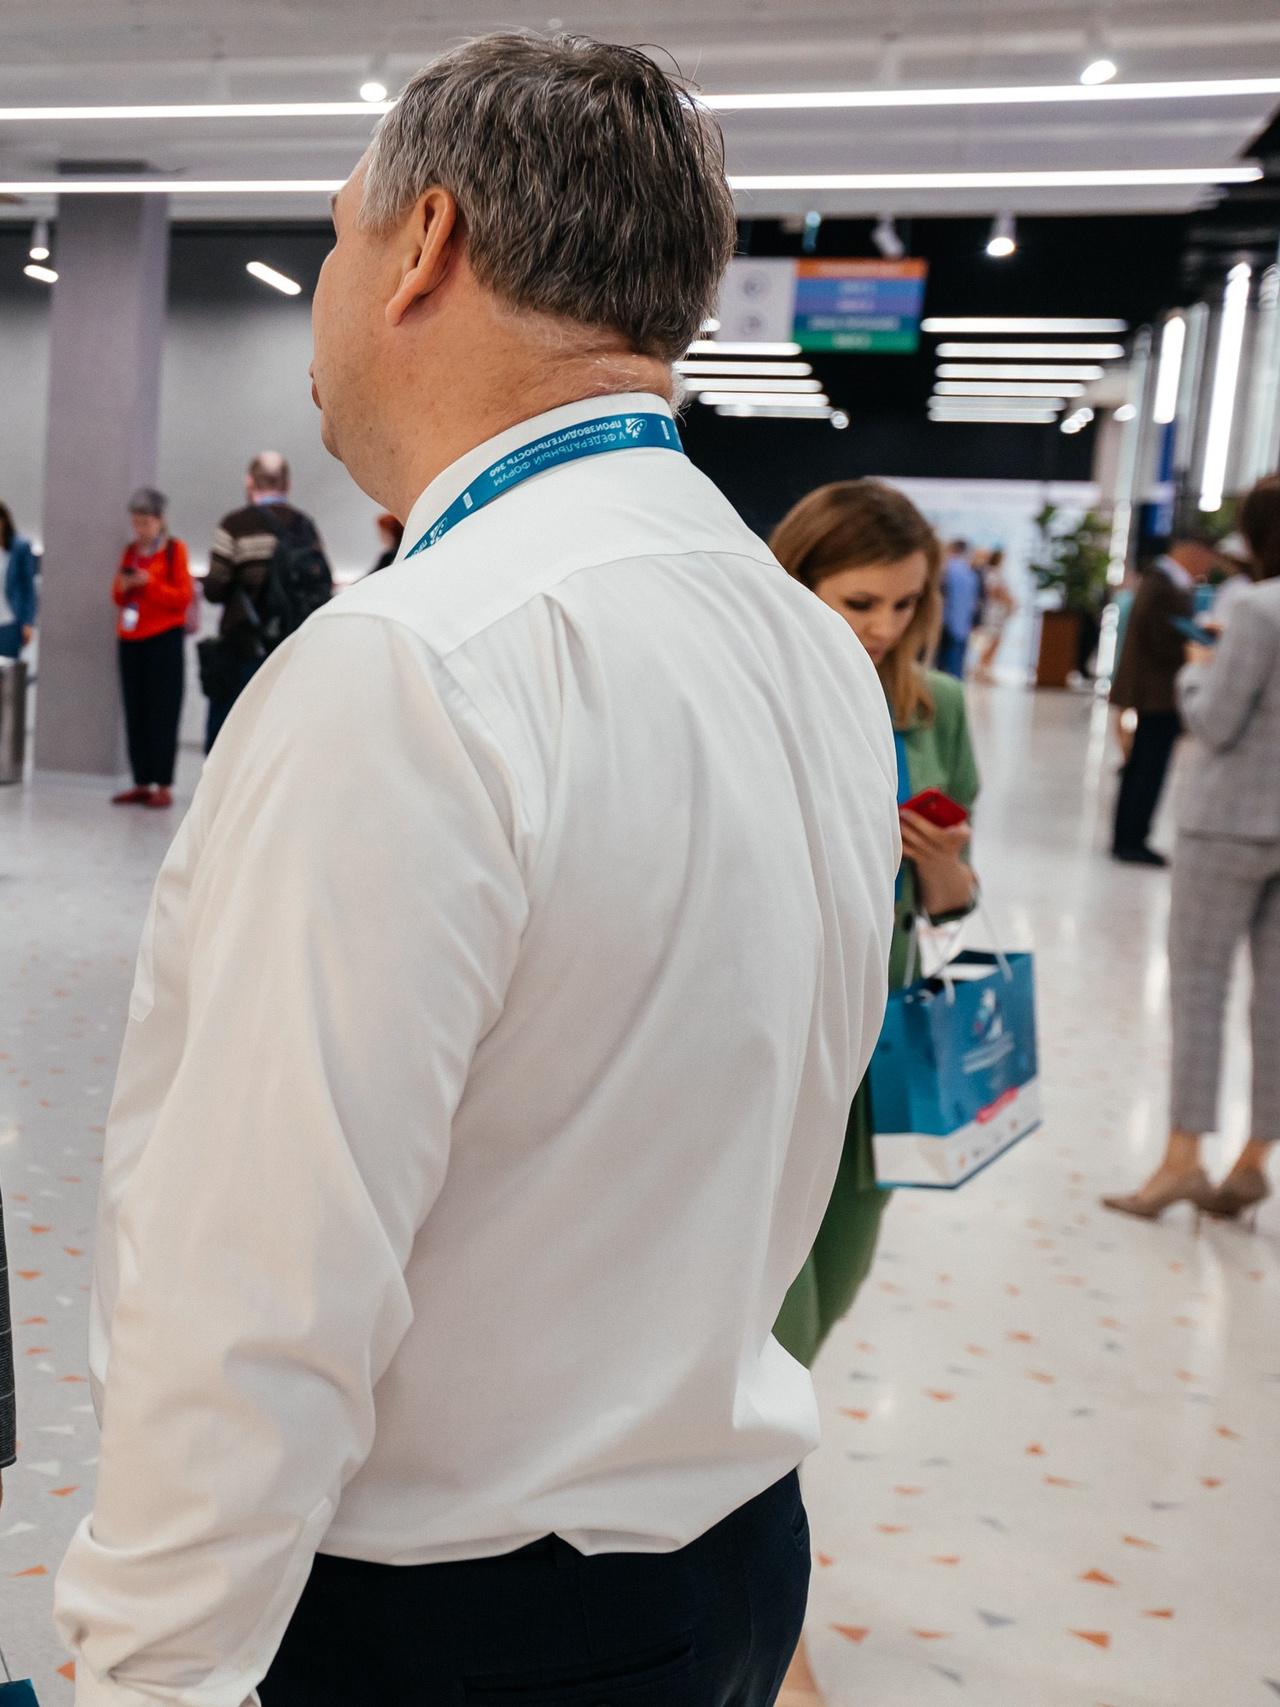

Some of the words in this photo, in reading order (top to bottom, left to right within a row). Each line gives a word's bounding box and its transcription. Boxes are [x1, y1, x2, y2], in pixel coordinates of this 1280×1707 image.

[506, 420, 622, 465] ПРОИЗВОДИТЕЛЬНОСТЬ
[533, 432, 617, 465] ФЕДЕРАЛЬНЫЙ
[489, 463, 507, 478] 360
[493, 461, 531, 487] ФОРУМ
